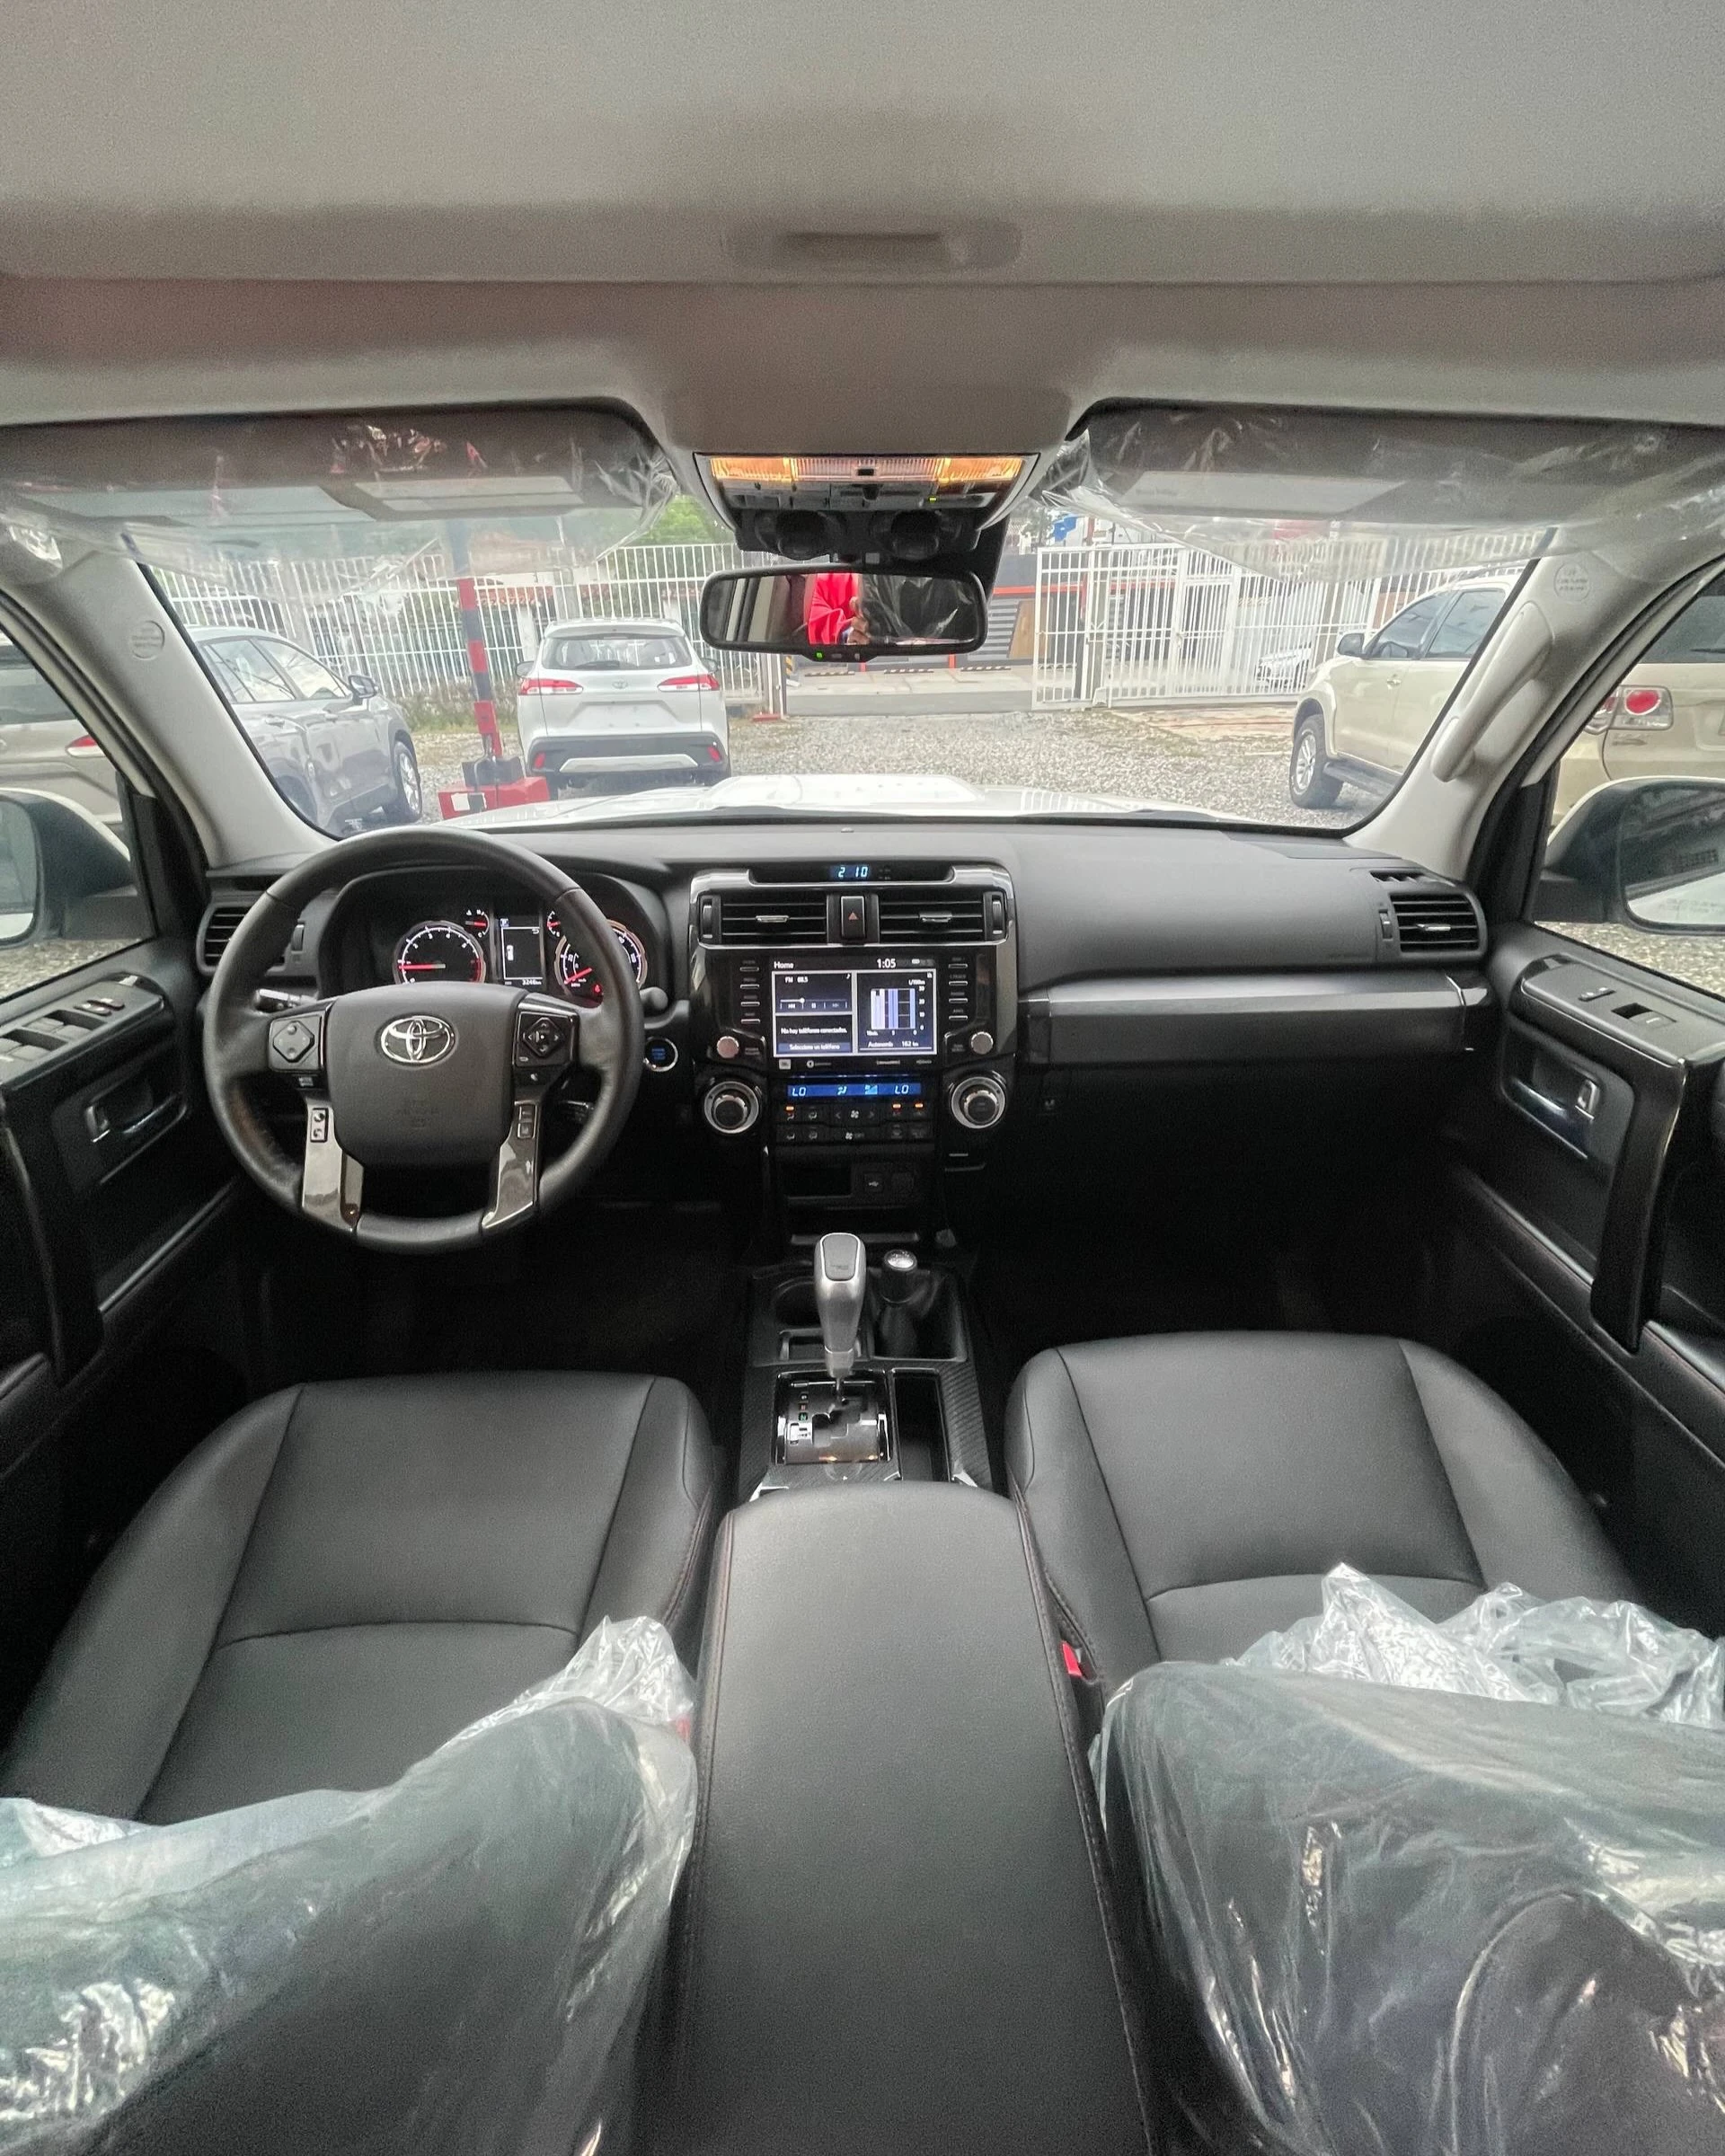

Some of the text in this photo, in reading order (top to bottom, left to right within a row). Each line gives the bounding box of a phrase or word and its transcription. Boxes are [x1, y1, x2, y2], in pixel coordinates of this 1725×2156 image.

[774, 961, 794, 969] Home
[876, 958, 897, 968] 1:05
[792, 1088, 807, 1096] LO
[894, 1085, 909, 1094] LO
